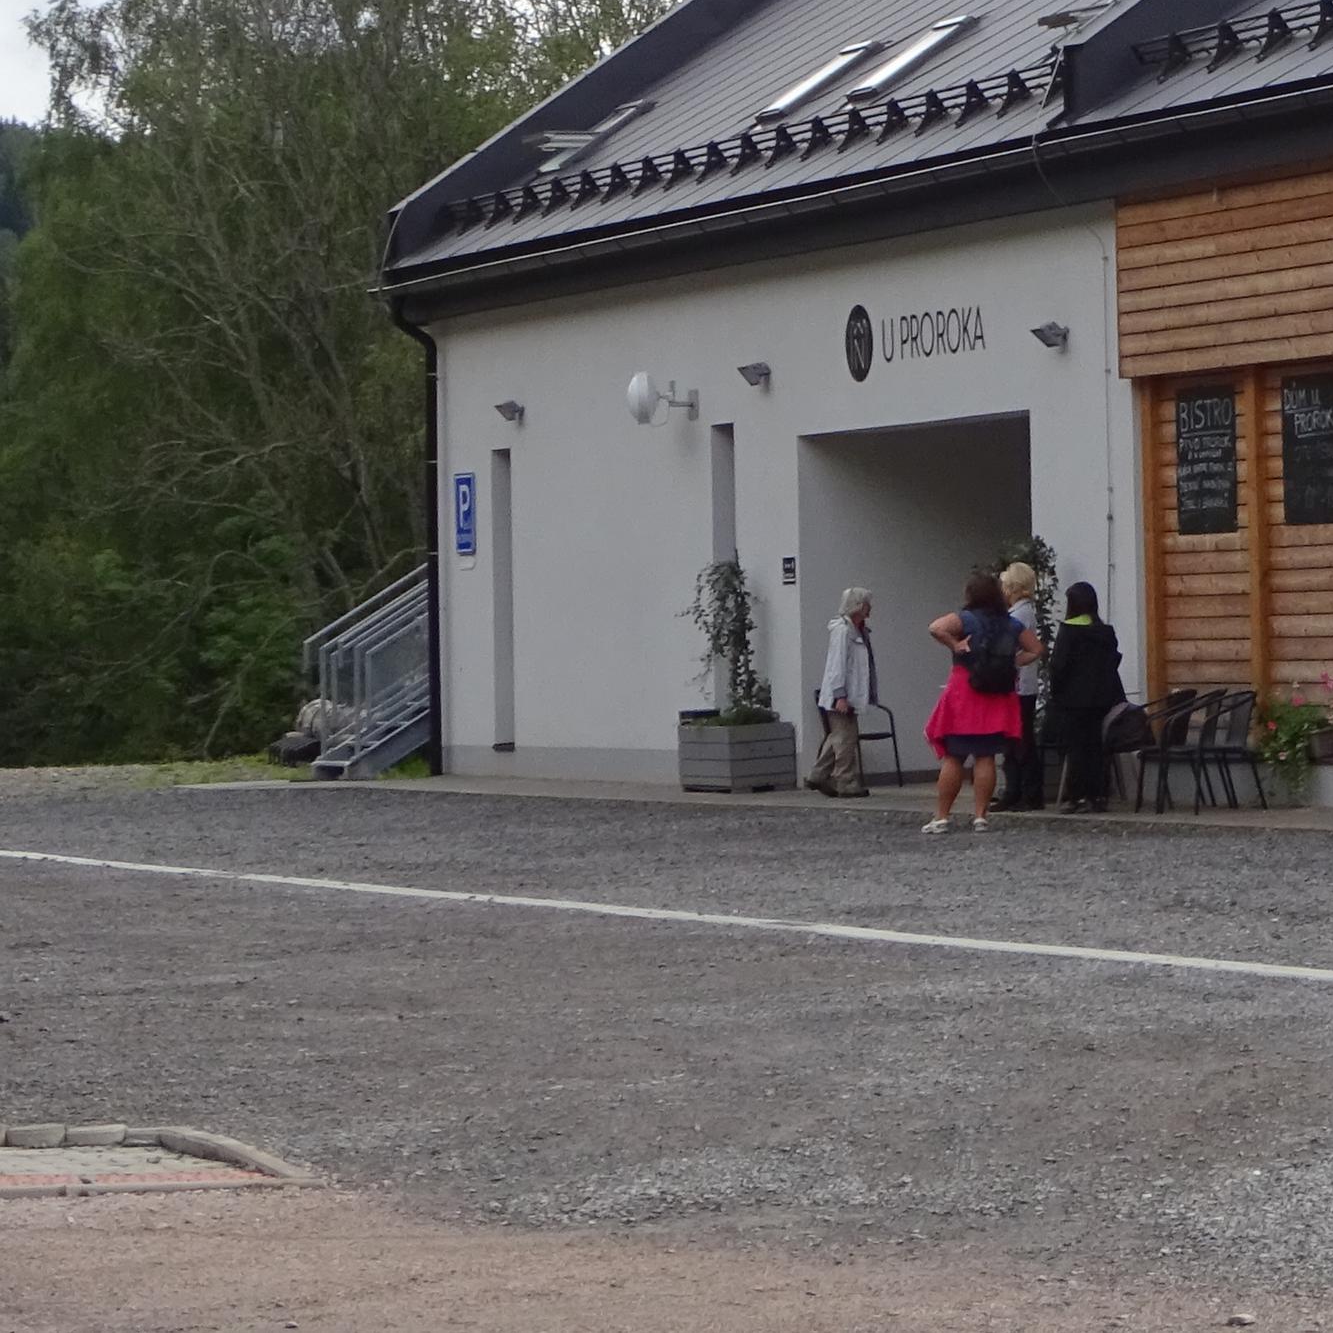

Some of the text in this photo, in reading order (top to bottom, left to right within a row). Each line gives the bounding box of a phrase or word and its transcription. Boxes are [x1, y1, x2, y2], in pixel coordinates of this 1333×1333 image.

[881, 318, 895, 363] U
[900, 304, 986, 360] PROROKA
[1179, 397, 1232, 432] BISTRO
[459, 484, 470, 528] P
